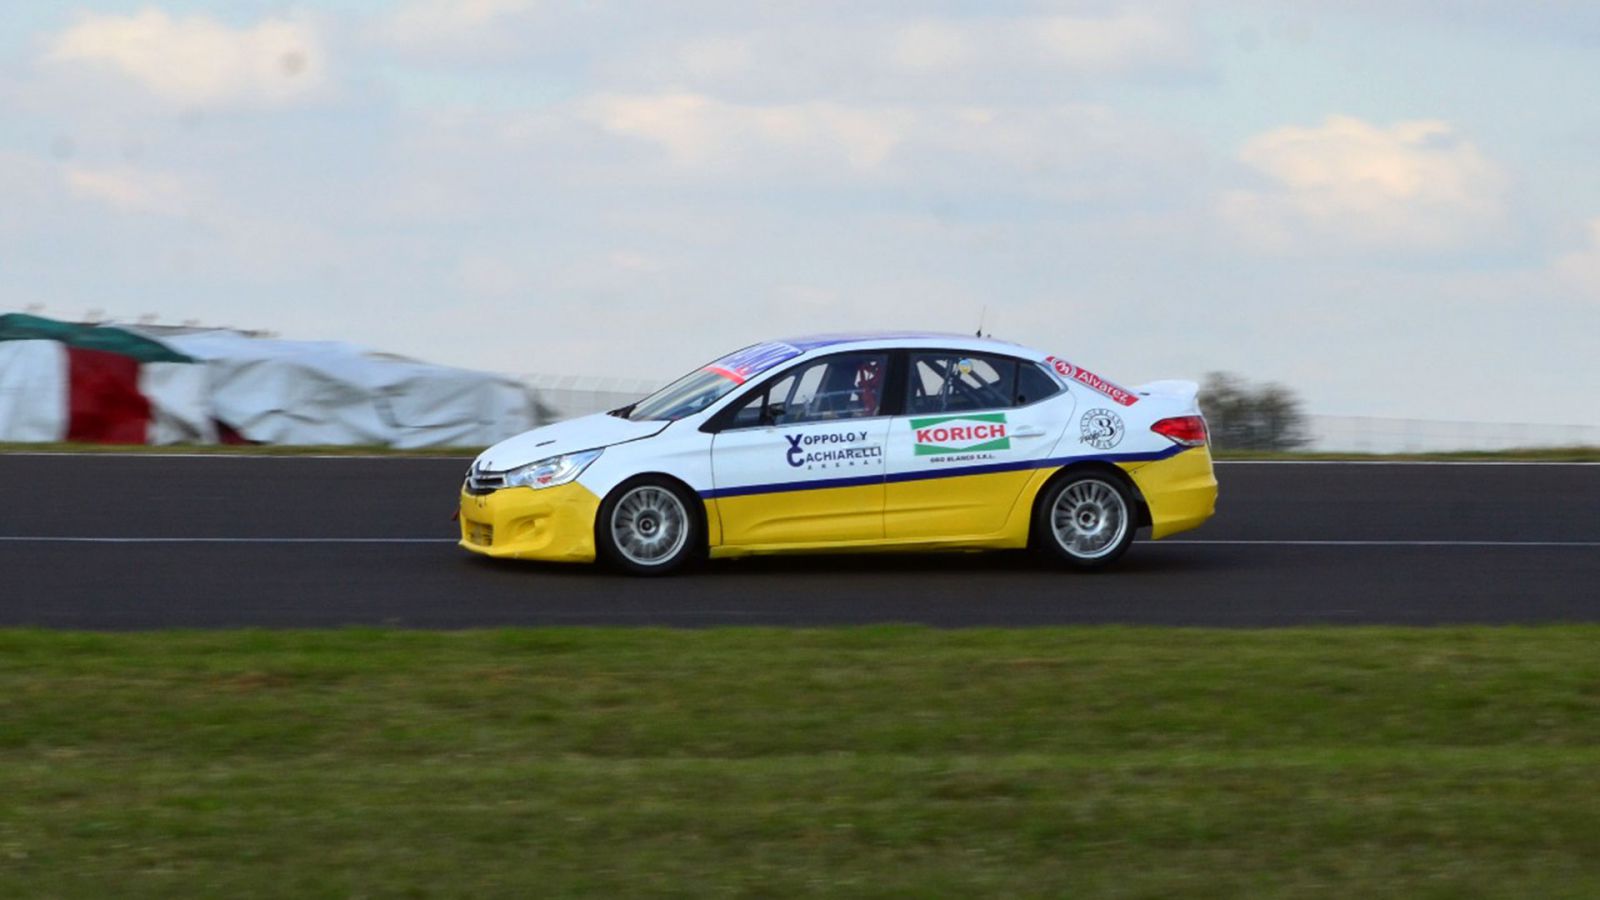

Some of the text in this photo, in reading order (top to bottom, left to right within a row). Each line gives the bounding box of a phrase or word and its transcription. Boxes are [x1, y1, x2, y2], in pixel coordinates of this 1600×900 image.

[1078, 371, 1129, 403] Alvarez
[860, 431, 868, 441] Y
[916, 424, 1006, 443] KORICH
